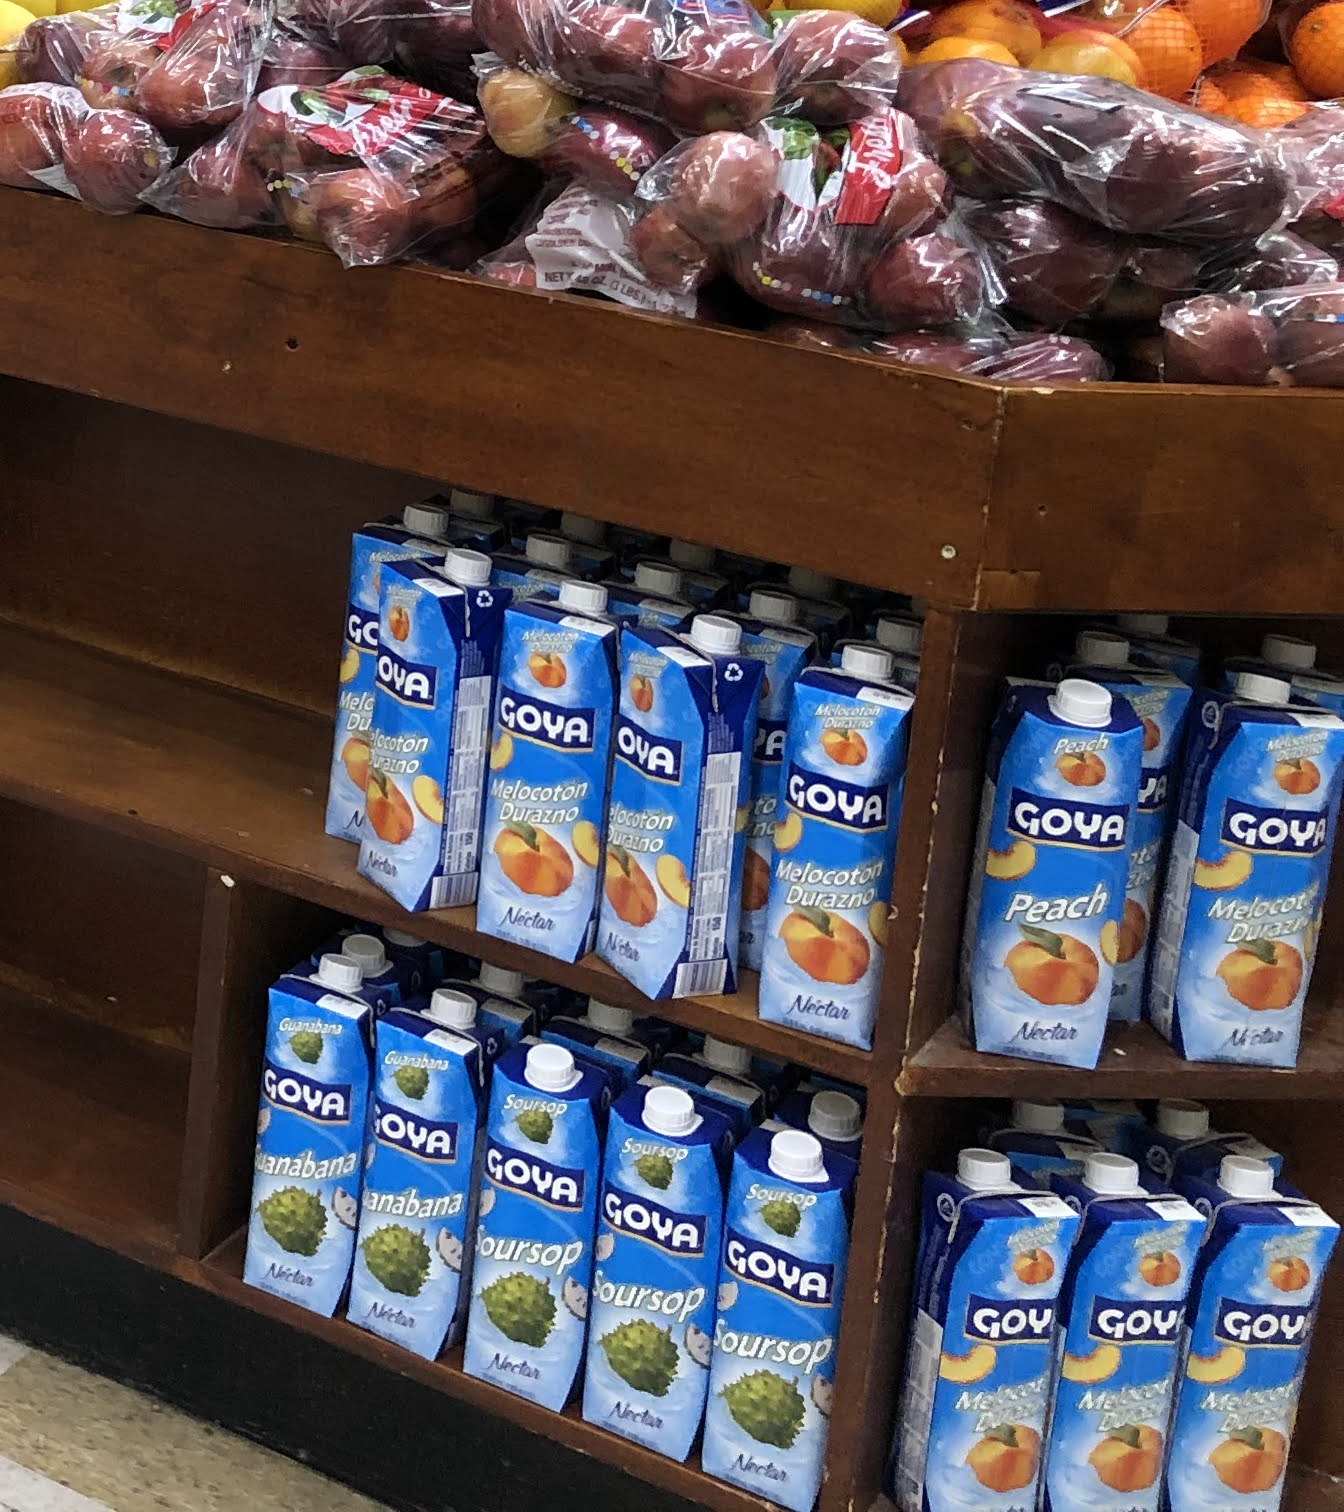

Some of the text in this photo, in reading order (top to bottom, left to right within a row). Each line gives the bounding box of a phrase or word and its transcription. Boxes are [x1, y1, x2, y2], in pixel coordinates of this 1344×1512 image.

[378, 655, 431, 700] OYA
[499, 696, 589, 744] GOYA
[617, 726, 676, 776] OYA
[1054, 732, 1109, 755] Peach
[491, 778, 589, 803] Melocotón
[788, 776, 883, 823] GOYA
[499, 803, 580, 823] Durazno
[1013, 801, 1125, 843] GOYA
[1228, 811, 1326, 849] GOYA
[775, 857, 884, 888] Melocotón
[785, 885, 875, 910] Durazno
[1004, 882, 1108, 924] Peach
[500, 906, 556, 932] Néctar
[787, 993, 850, 1021] Néctar
[1012, 1020, 1079, 1045] Nectar
[264, 1068, 346, 1117] GOYA
[503, 1093, 568, 1117] Soursop
[256, 1150, 357, 1180] uanábana
[621, 1137, 688, 1162] Soursop
[487, 1147, 577, 1203] GOYA
[745, 1183, 818, 1210] Soursop
[605, 1192, 699, 1249] GOYA
[727, 1239, 828, 1300] GOYA
[972, 1307, 1053, 1339] GOY
[1097, 1306, 1184, 1339] GOY
[1223, 1309, 1309, 1341] GOY
[714, 1318, 833, 1376] Soursop
[489, 1352, 541, 1381] Nectar
[610, 1400, 663, 1429] Nectar
[730, 1453, 790, 1483] Nectar
